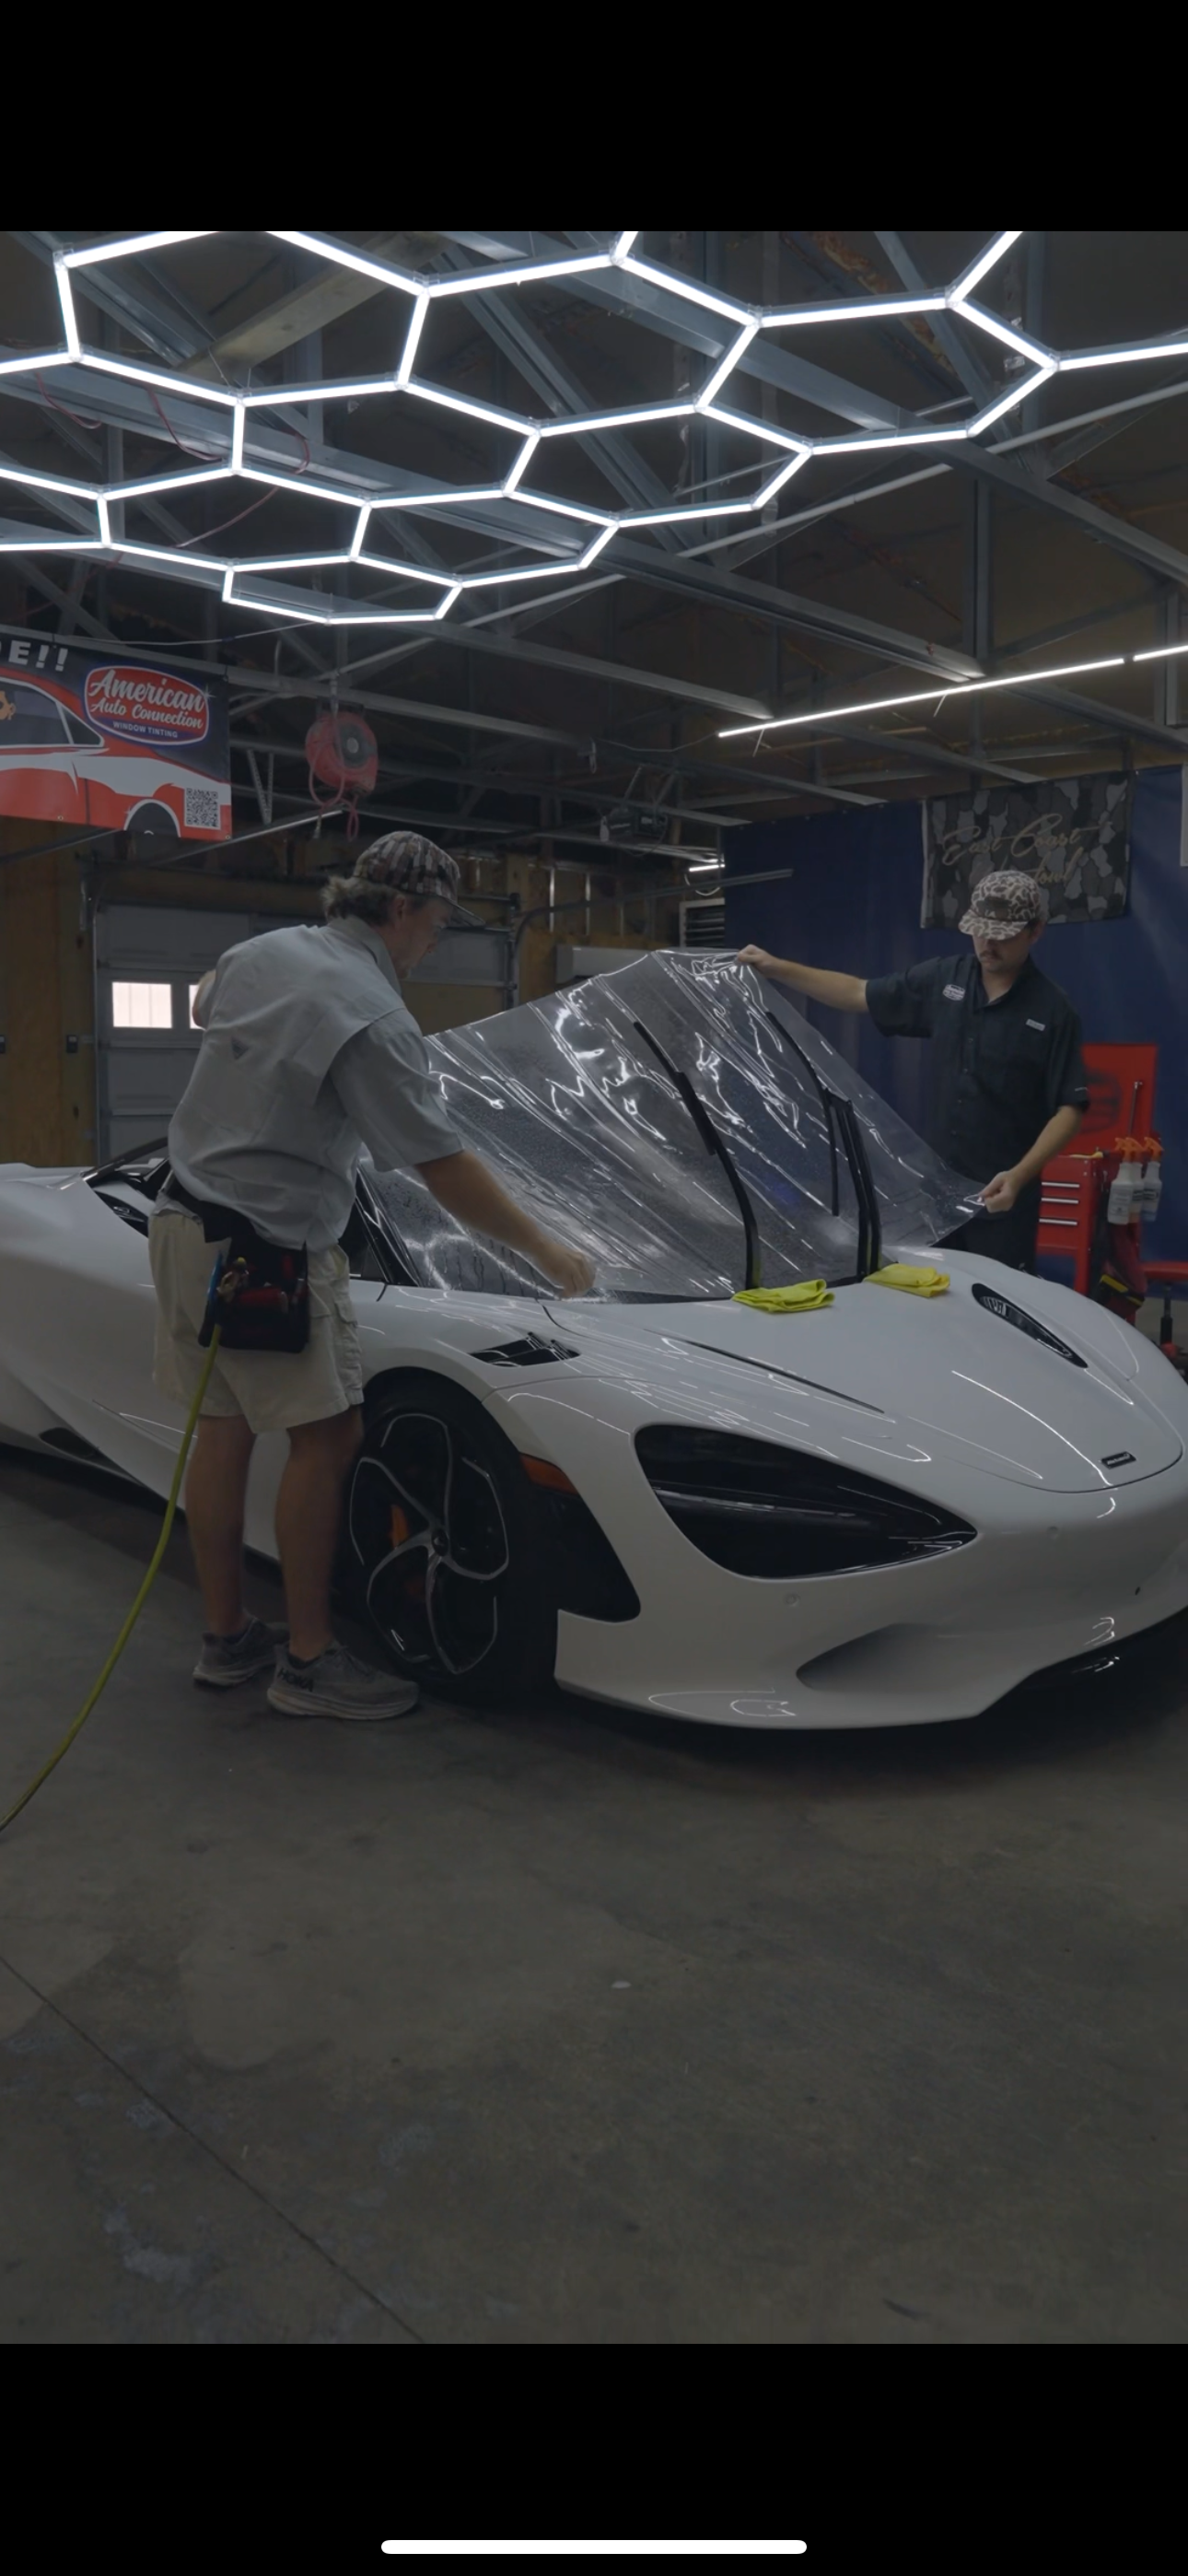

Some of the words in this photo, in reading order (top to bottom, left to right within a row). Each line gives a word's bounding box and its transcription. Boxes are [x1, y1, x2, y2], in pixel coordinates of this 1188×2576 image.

[0, 639, 68, 673] E!!
[88, 669, 204, 713] American
[90, 697, 127, 716] Auto
[132, 704, 204, 729] Connection
[112, 720, 146, 733] WINDOW
[148, 726, 178, 739] TINTING
[942, 825, 1007, 866] East
[1011, 813, 1101, 858] Coast
[276, 1668, 314, 1693] HOKA
